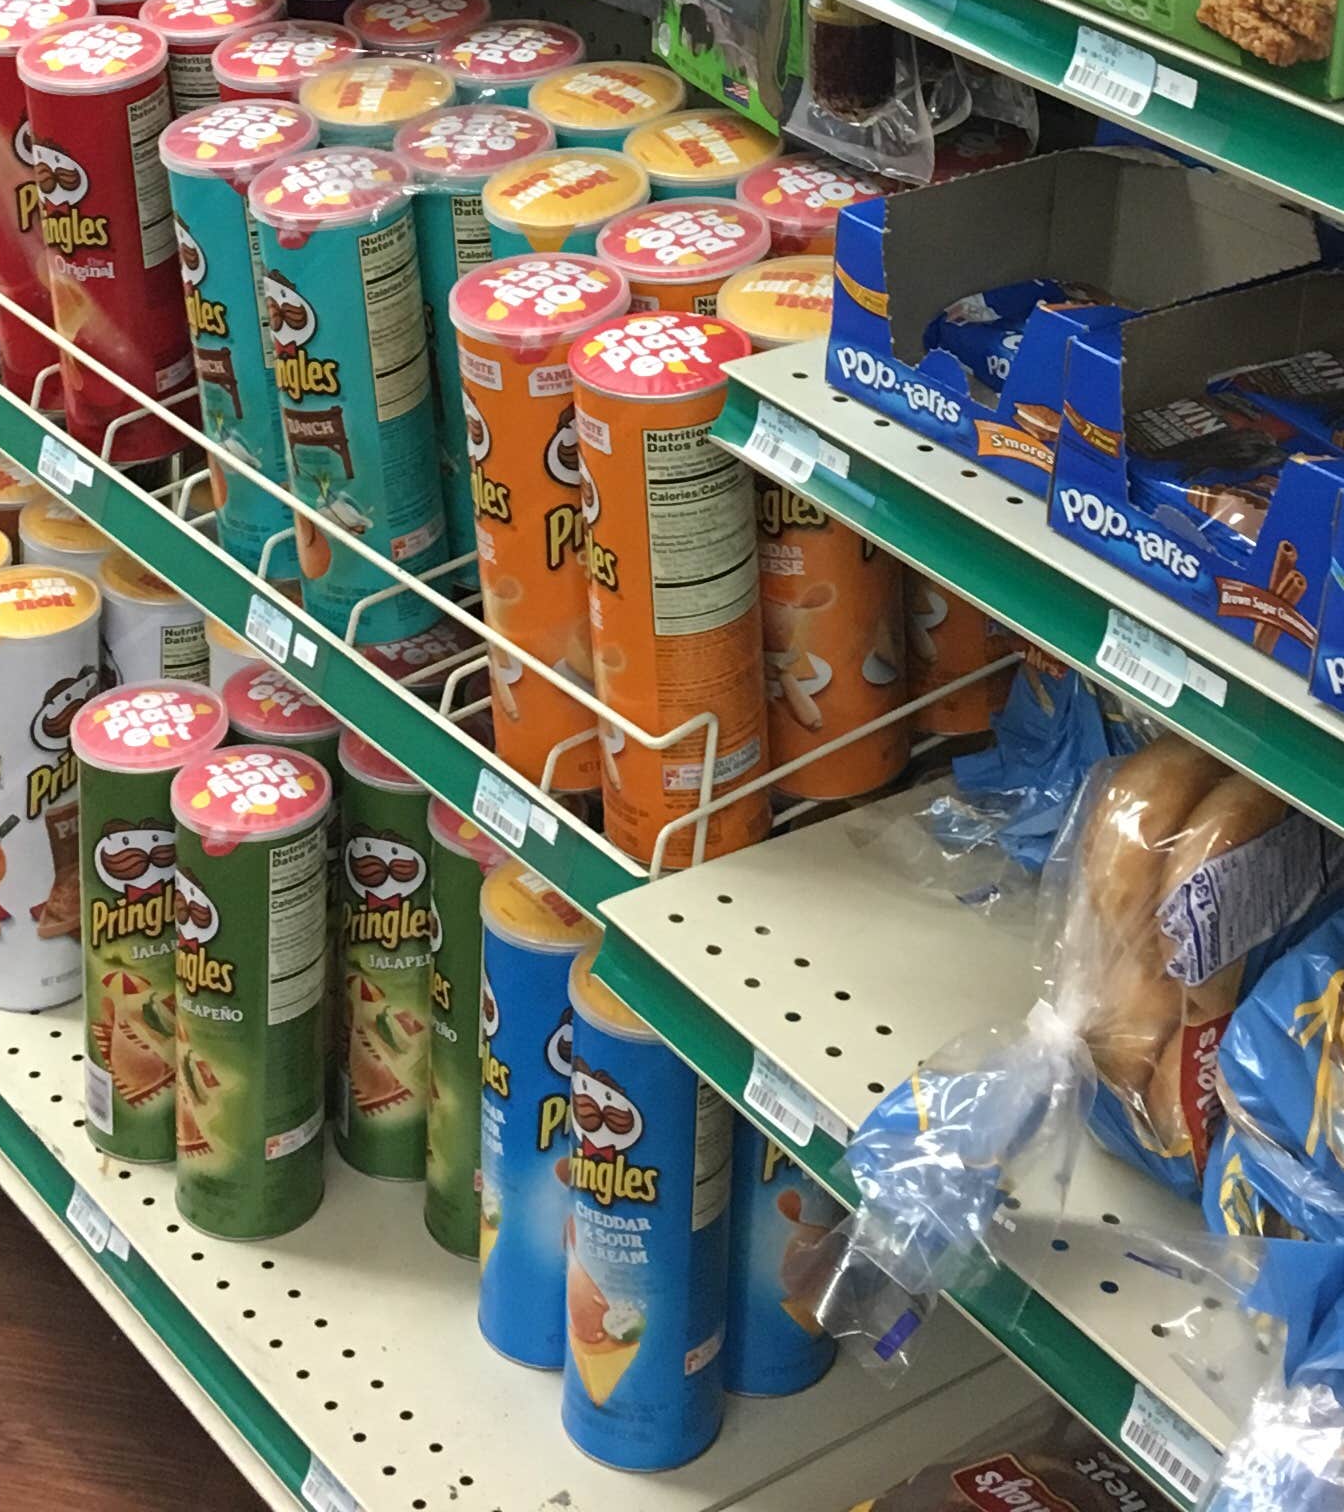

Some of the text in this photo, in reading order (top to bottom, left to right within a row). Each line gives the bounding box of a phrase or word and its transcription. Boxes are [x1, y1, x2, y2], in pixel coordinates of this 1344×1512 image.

[574, 1202, 652, 1233] CHEDDAR
[595, 1229, 645, 1250] SOUR
[585, 1244, 649, 1267] CREAM
